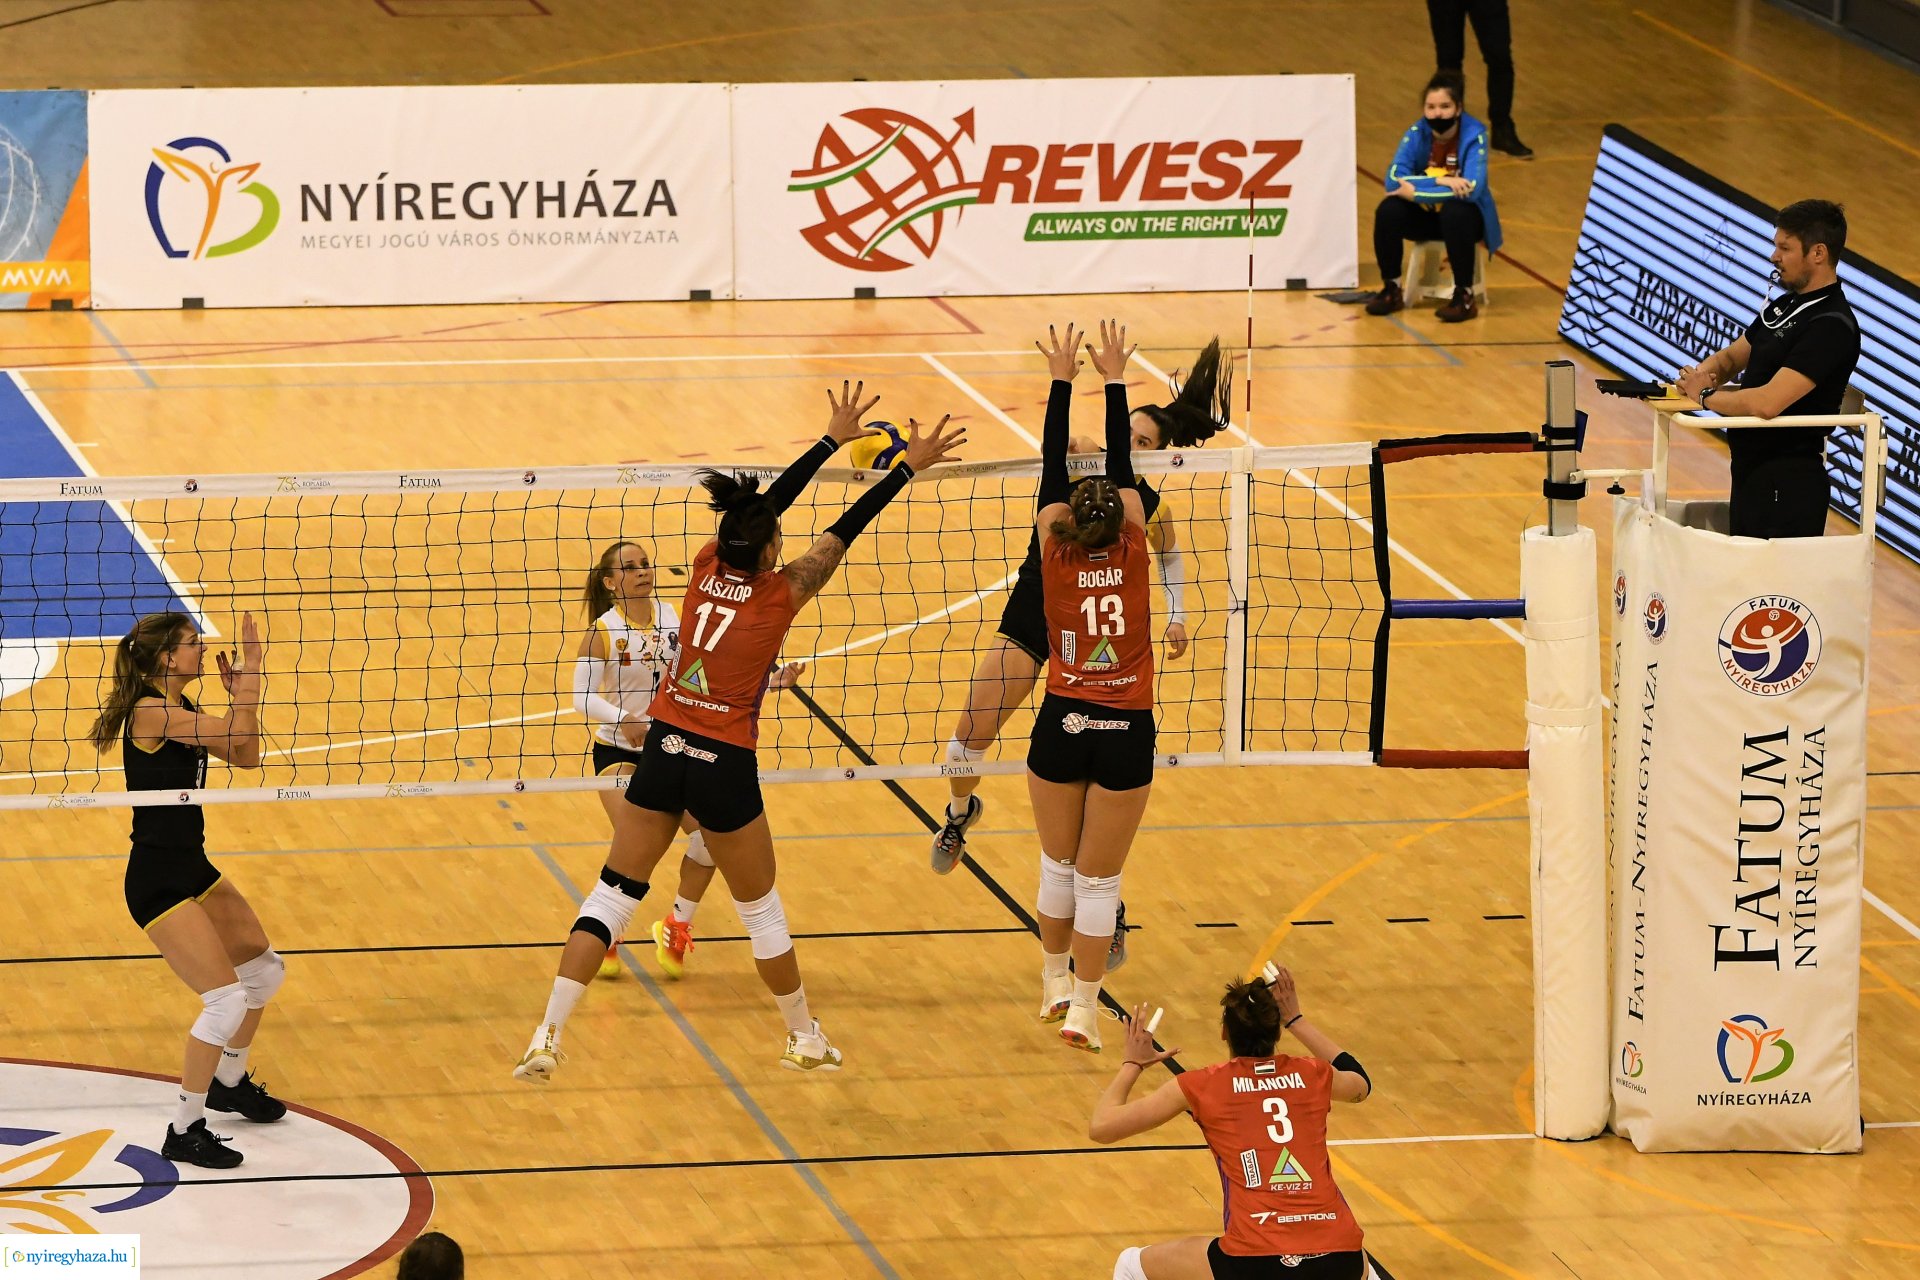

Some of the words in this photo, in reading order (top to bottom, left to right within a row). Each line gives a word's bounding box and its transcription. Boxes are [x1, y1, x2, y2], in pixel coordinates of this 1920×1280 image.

[978, 139, 1303, 204] REVESZ
[300, 169, 678, 222] NYÍREGYHÁZA
[1032, 218, 1106, 234] ALWAYS
[1111, 217, 1138, 233] ON
[1142, 216, 1177, 232] THE
[1181, 215, 1237, 231] RIGHT
[1242, 214, 1282, 230] WAY
[301, 234, 371, 249] MEGYEI
[379, 230, 429, 248] JOGÚ
[437, 229, 500, 247] VÁROS
[507, 227, 679, 247] ÖNKORMÁNYZATA
[2, 267, 72, 287] MVM
[1078, 566, 1123, 588] BOGÁR
[1080, 594, 1126, 636] 13
[1748, 597, 1801, 614] FATUM
[692, 601, 737, 652] 17
[1083, 675, 1138, 686] BESTRONG
[1723, 658, 1815, 694] NYÍREGYHÁZA
[674, 695, 730, 713] BESTRONG
[1708, 725, 1789, 972] FATUM
[1789, 724, 1827, 970] NYÍREGYHÁZA
[1233, 1072, 1306, 1093] MILANOVA
[1697, 1089, 1812, 1106] NYÍREGYHÁZA
[1262, 1097, 1294, 1144] 3
[1245, 1152, 1257, 1187] STRABAG
[1270, 1183, 1301, 1191] KE-VIZ
[1303, 1182, 1313, 1190] 21
[1277, 1212, 1336, 1224] BESTRONG
